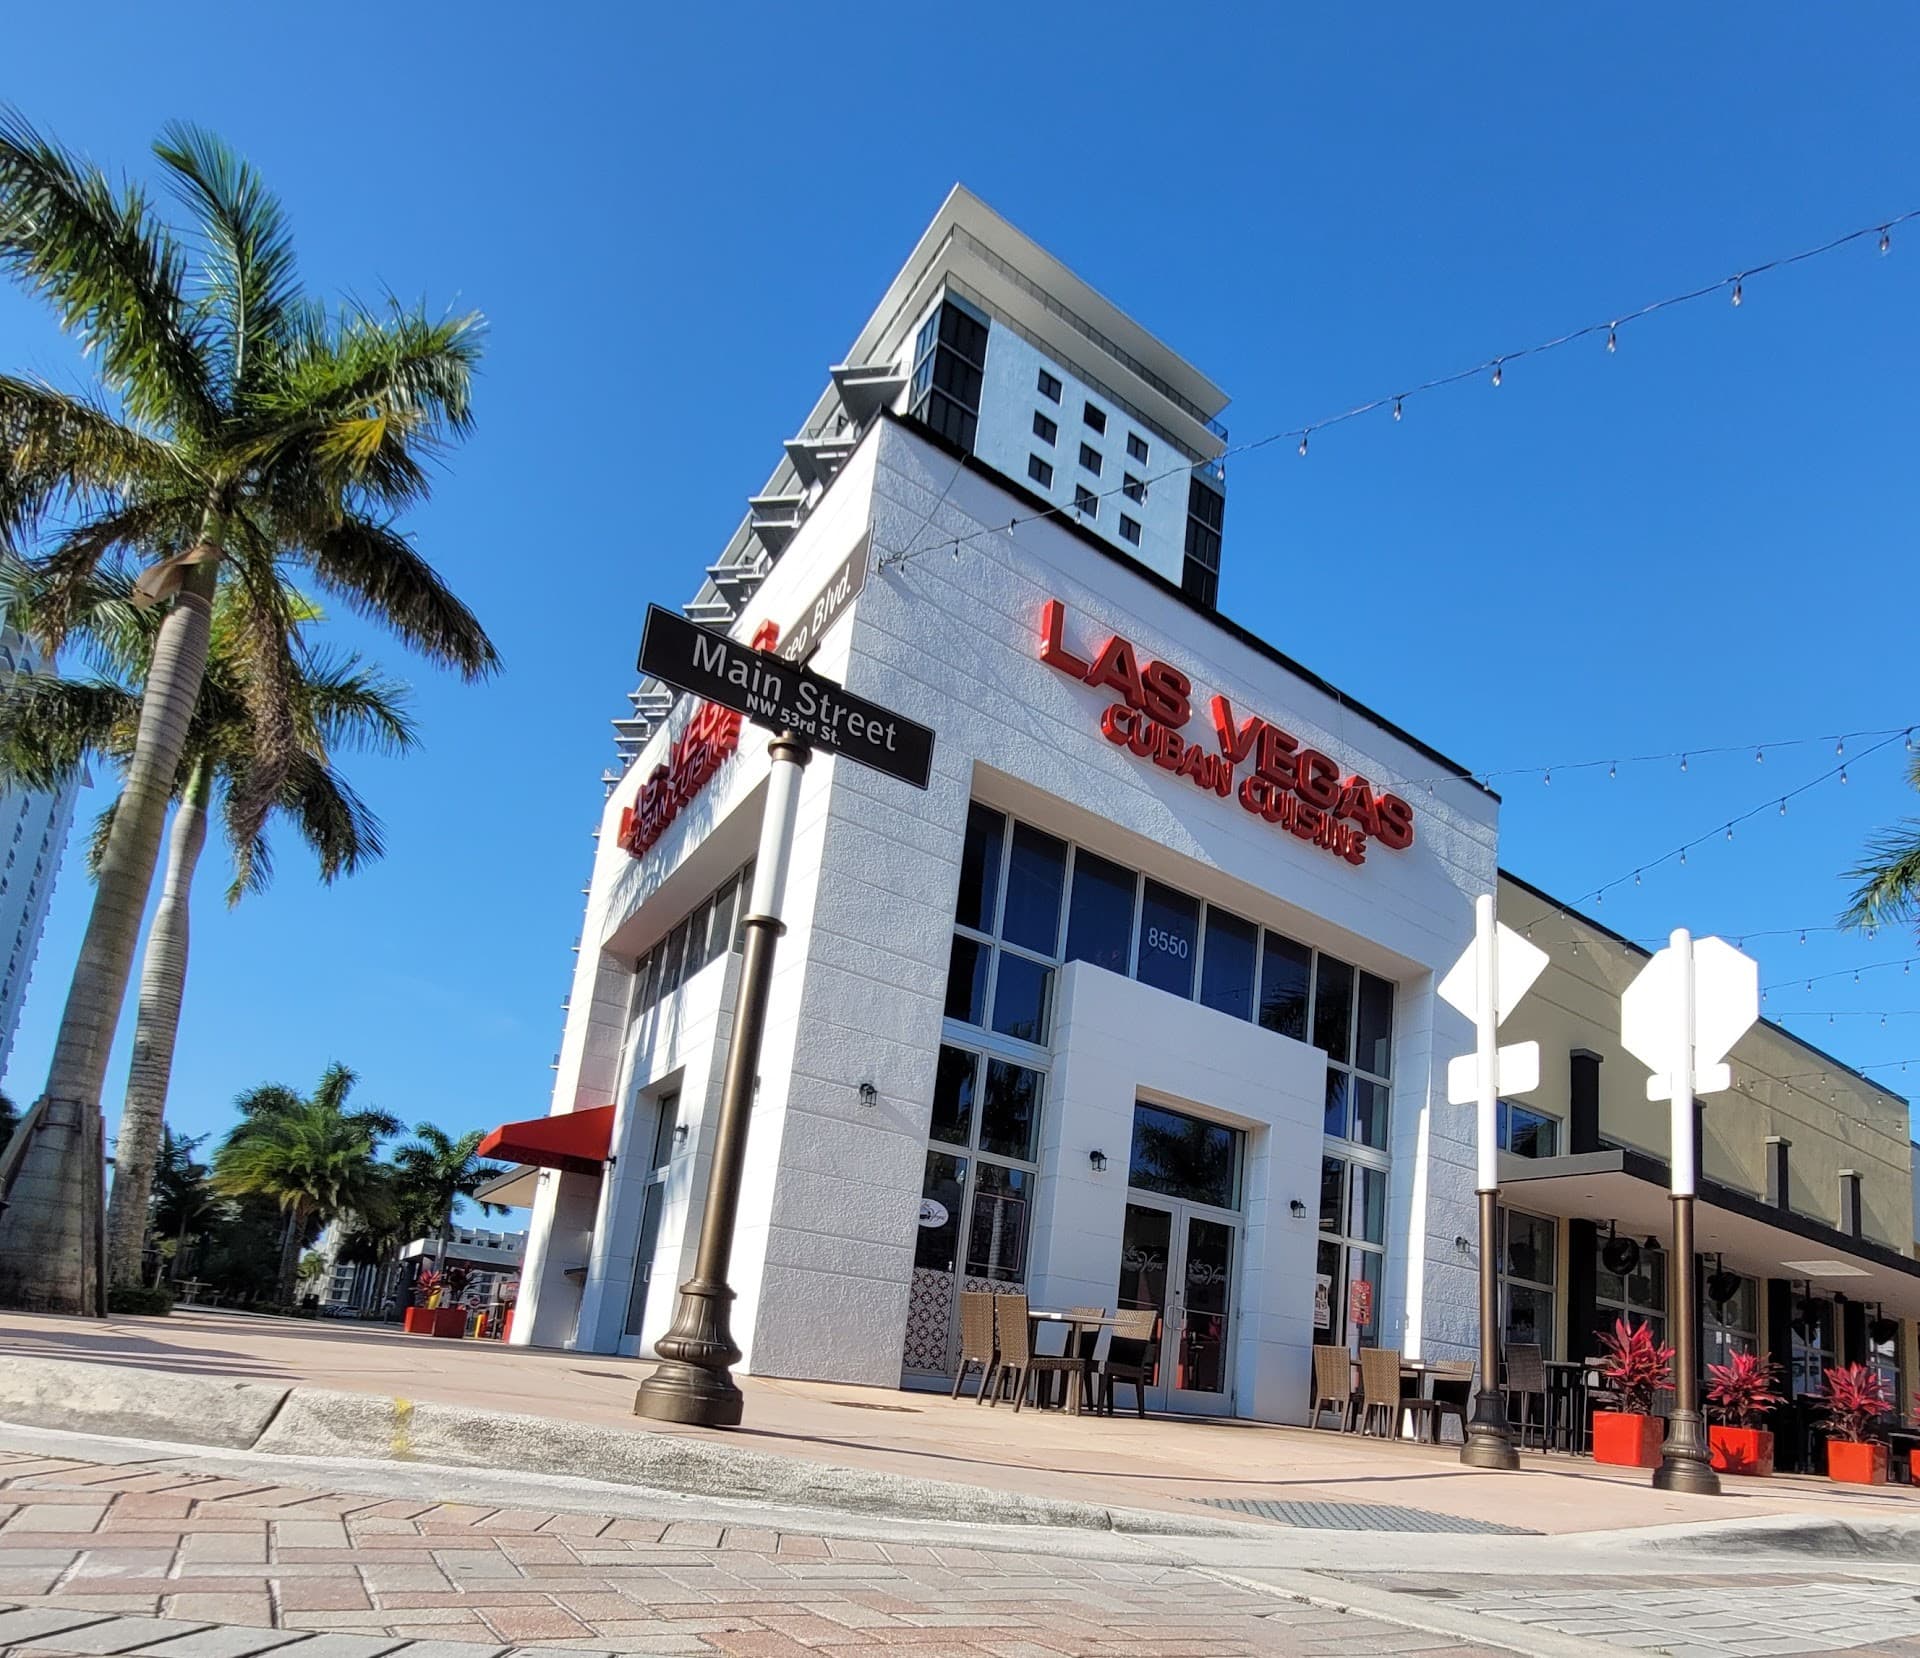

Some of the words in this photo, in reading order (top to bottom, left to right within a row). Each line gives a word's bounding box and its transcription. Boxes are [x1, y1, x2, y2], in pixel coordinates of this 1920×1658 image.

[811, 562, 851, 637] Blvd.
[692, 633, 782, 701] Main
[796, 681, 896, 752] Street
[746, 693, 776, 717] NW
[779, 708, 816, 735] 53rd
[820, 725, 842, 746] St.
[1039, 599, 1193, 730] LAS
[1210, 694, 1414, 850] VEGAS
[1101, 703, 1234, 797] CUBAN
[1238, 775, 1367, 866] CUISINE
[1148, 927, 1188, 959] 8550
